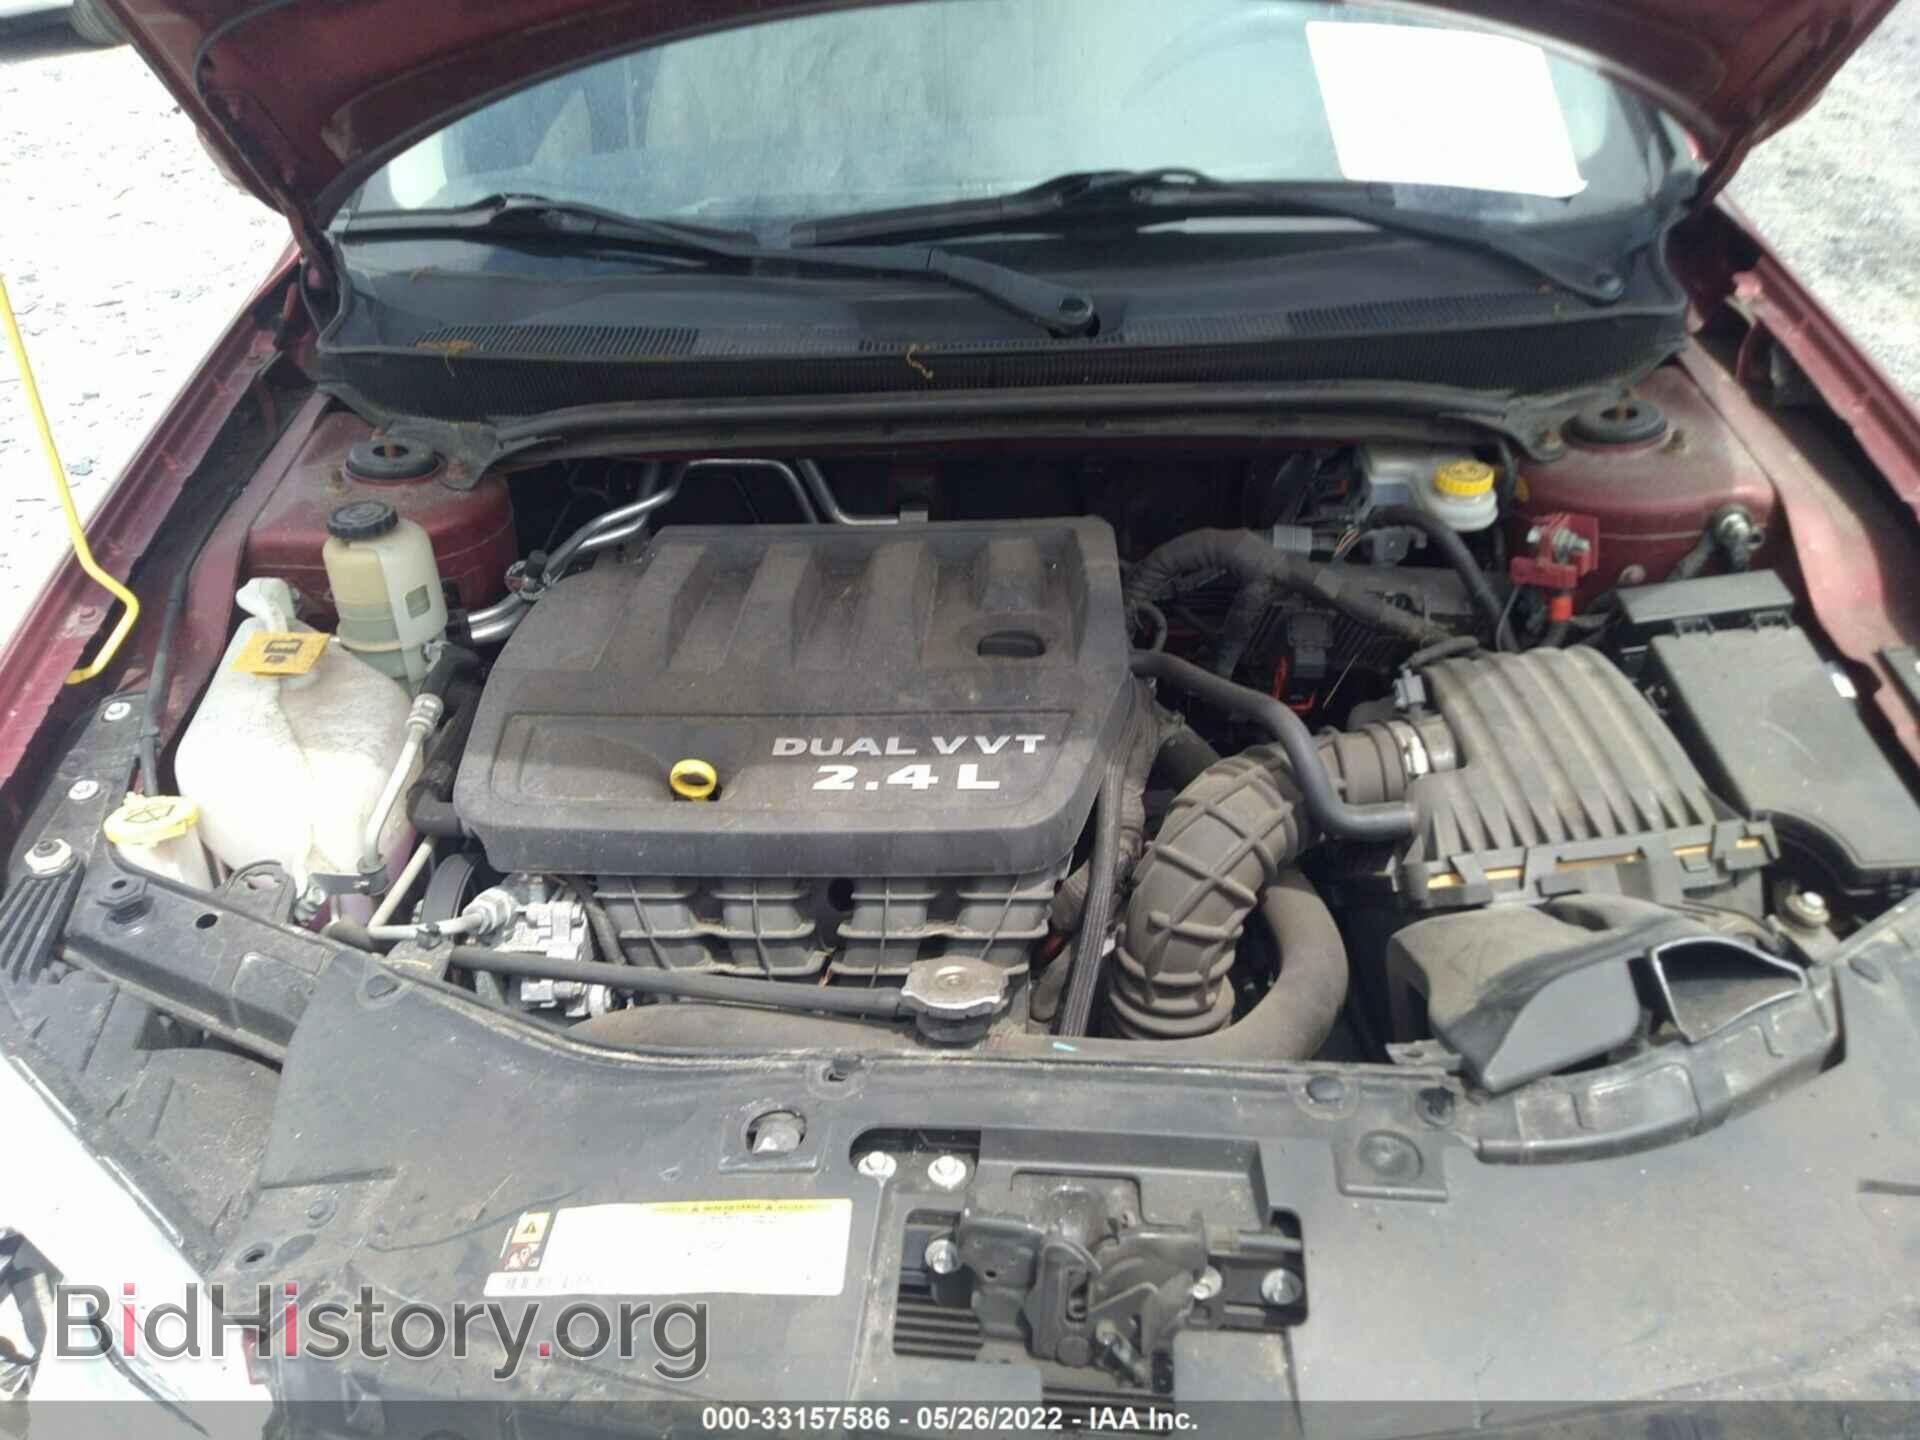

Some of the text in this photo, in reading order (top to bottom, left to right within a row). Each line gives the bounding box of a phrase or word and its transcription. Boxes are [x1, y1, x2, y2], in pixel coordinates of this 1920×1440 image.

[771, 734, 1046, 756] DUAL VVT
[811, 763, 1000, 790] 2.4 L
